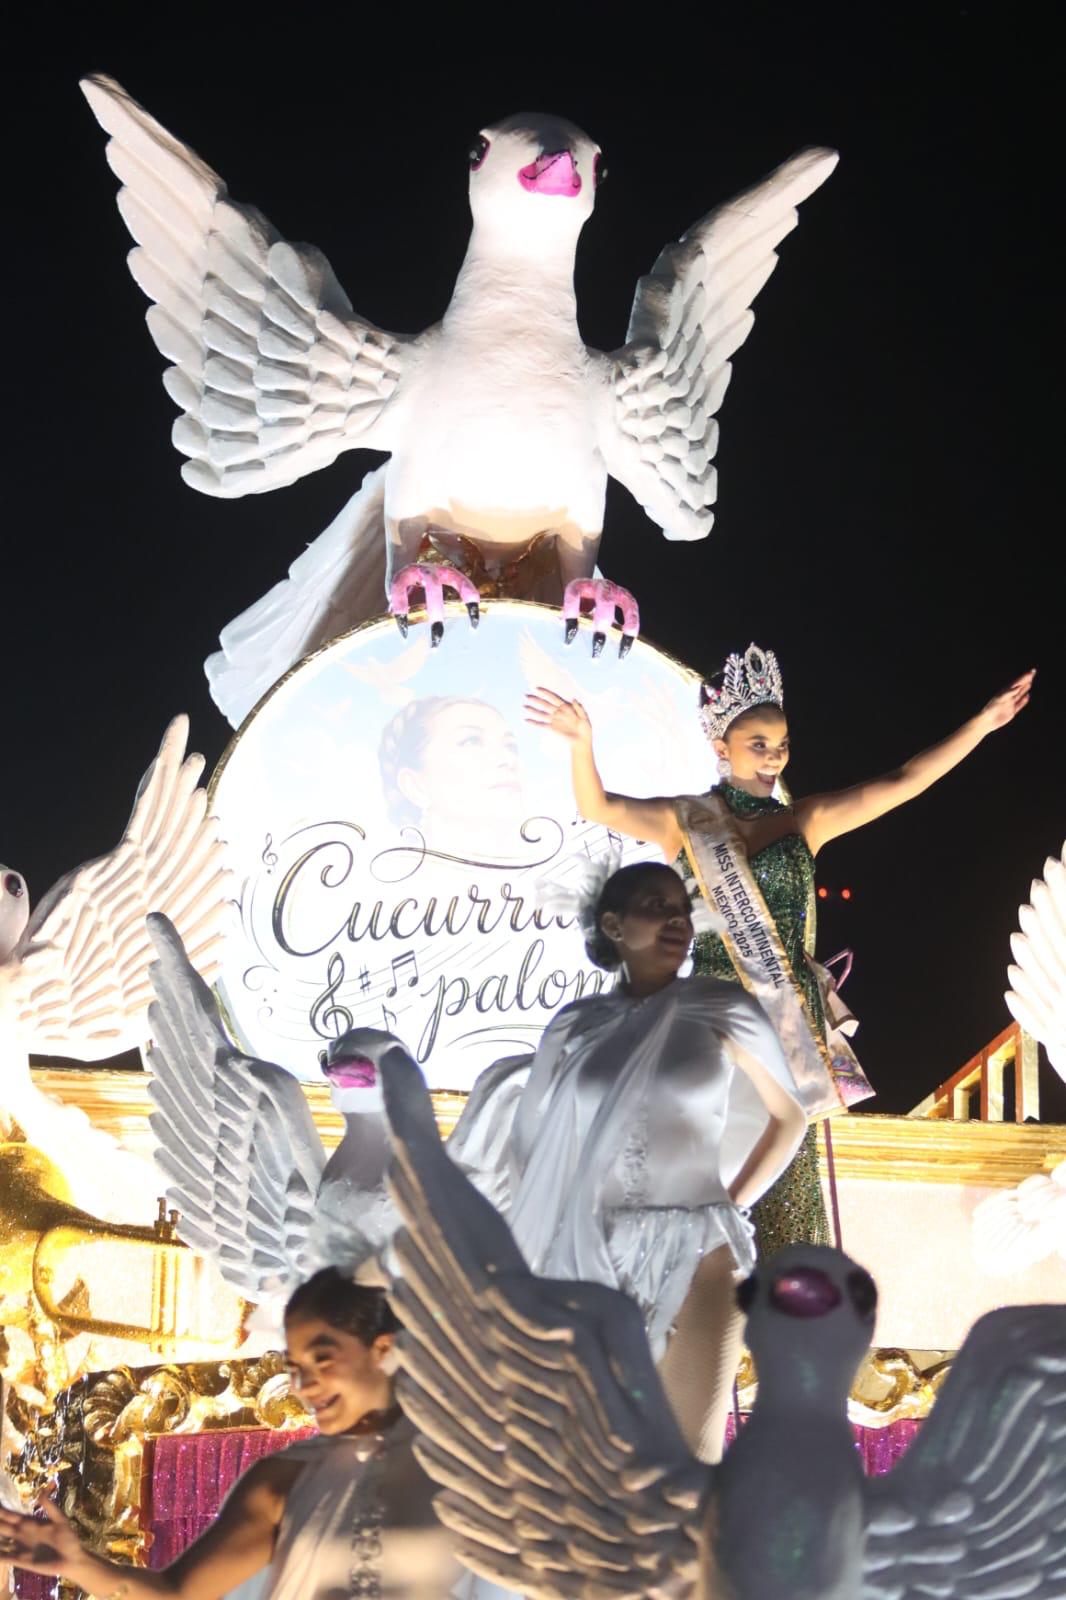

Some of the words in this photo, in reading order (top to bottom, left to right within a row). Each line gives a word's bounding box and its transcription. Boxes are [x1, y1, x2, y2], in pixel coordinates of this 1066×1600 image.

[712, 885, 738, 929] MÉXICO
[733, 930, 754, 958] 2025
[713, 843, 734, 872] MISS
[724, 871, 786, 990] INTERCONTINENTAL
[420, 939, 618, 1063] palom
